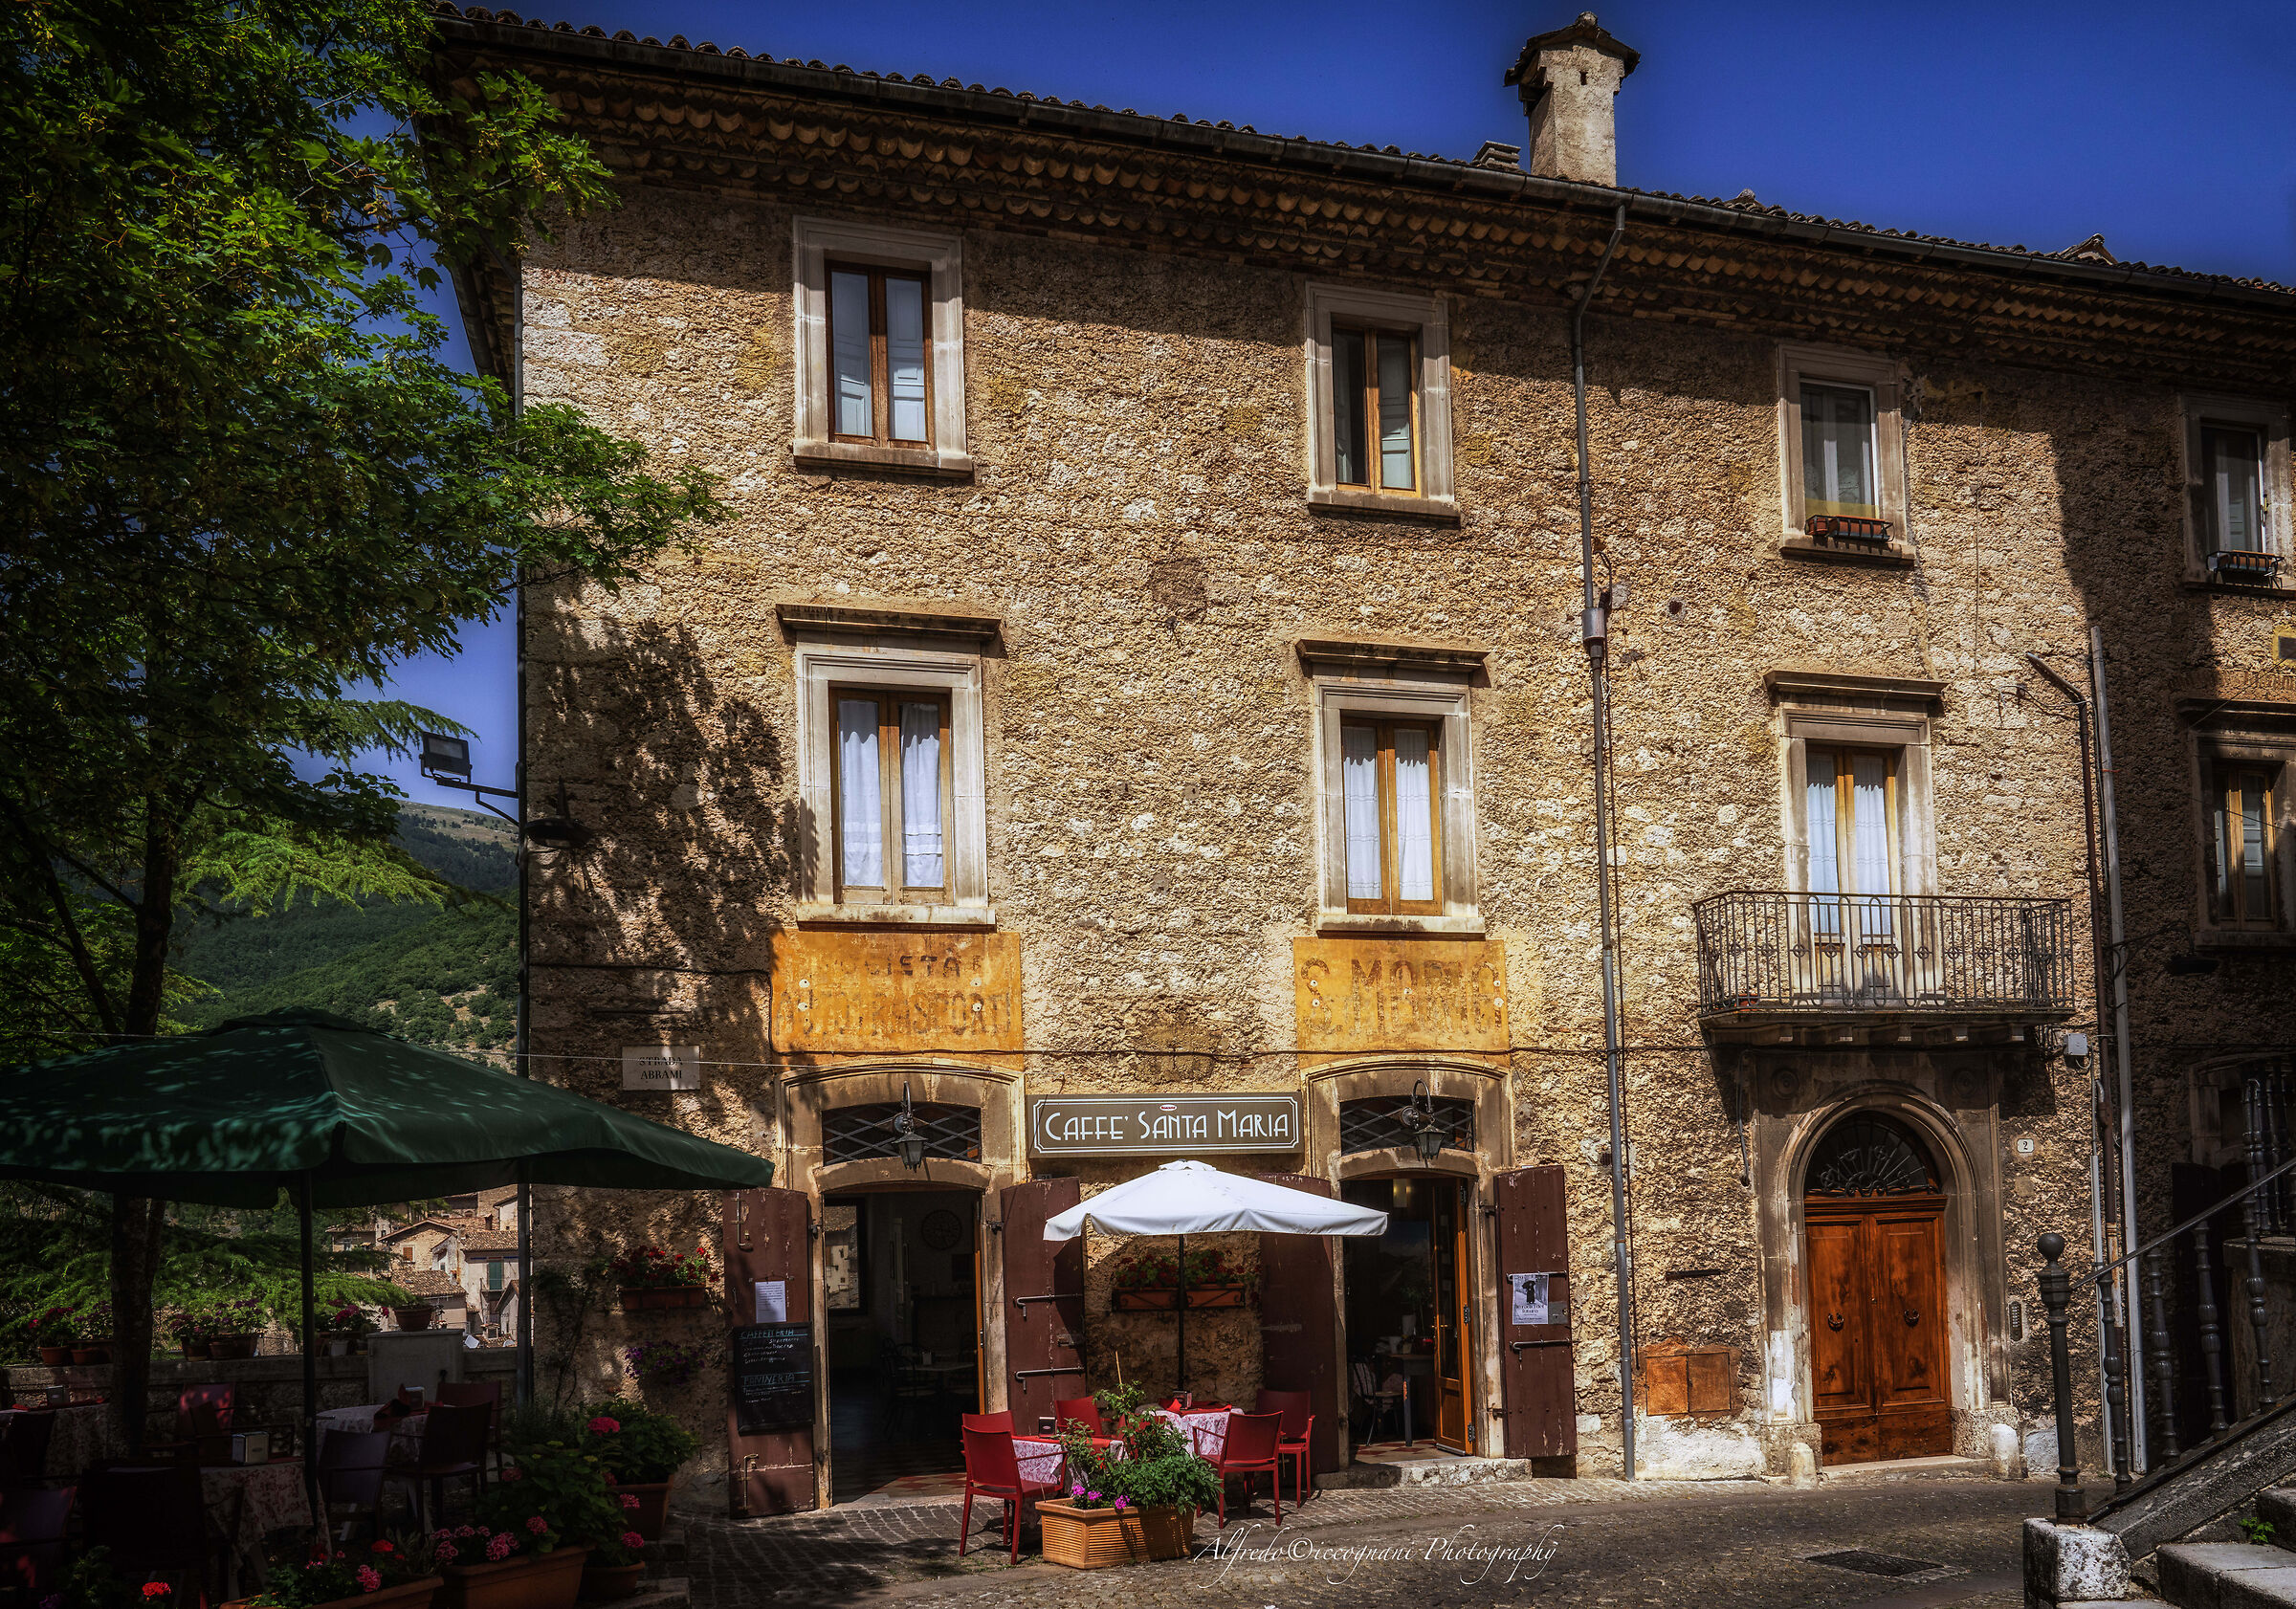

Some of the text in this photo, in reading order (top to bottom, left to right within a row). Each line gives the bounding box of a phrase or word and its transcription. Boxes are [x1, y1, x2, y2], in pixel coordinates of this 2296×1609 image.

[1351, 959, 1502, 1035] MARIA
[639, 1056, 683, 1066] STRADA
[640, 1069, 682, 1080] ABRAMI
[1137, 1111, 1207, 1139] SANTA
[1217, 1109, 1289, 1138] MARIA
[2023, 1140, 2028, 1151] 2
